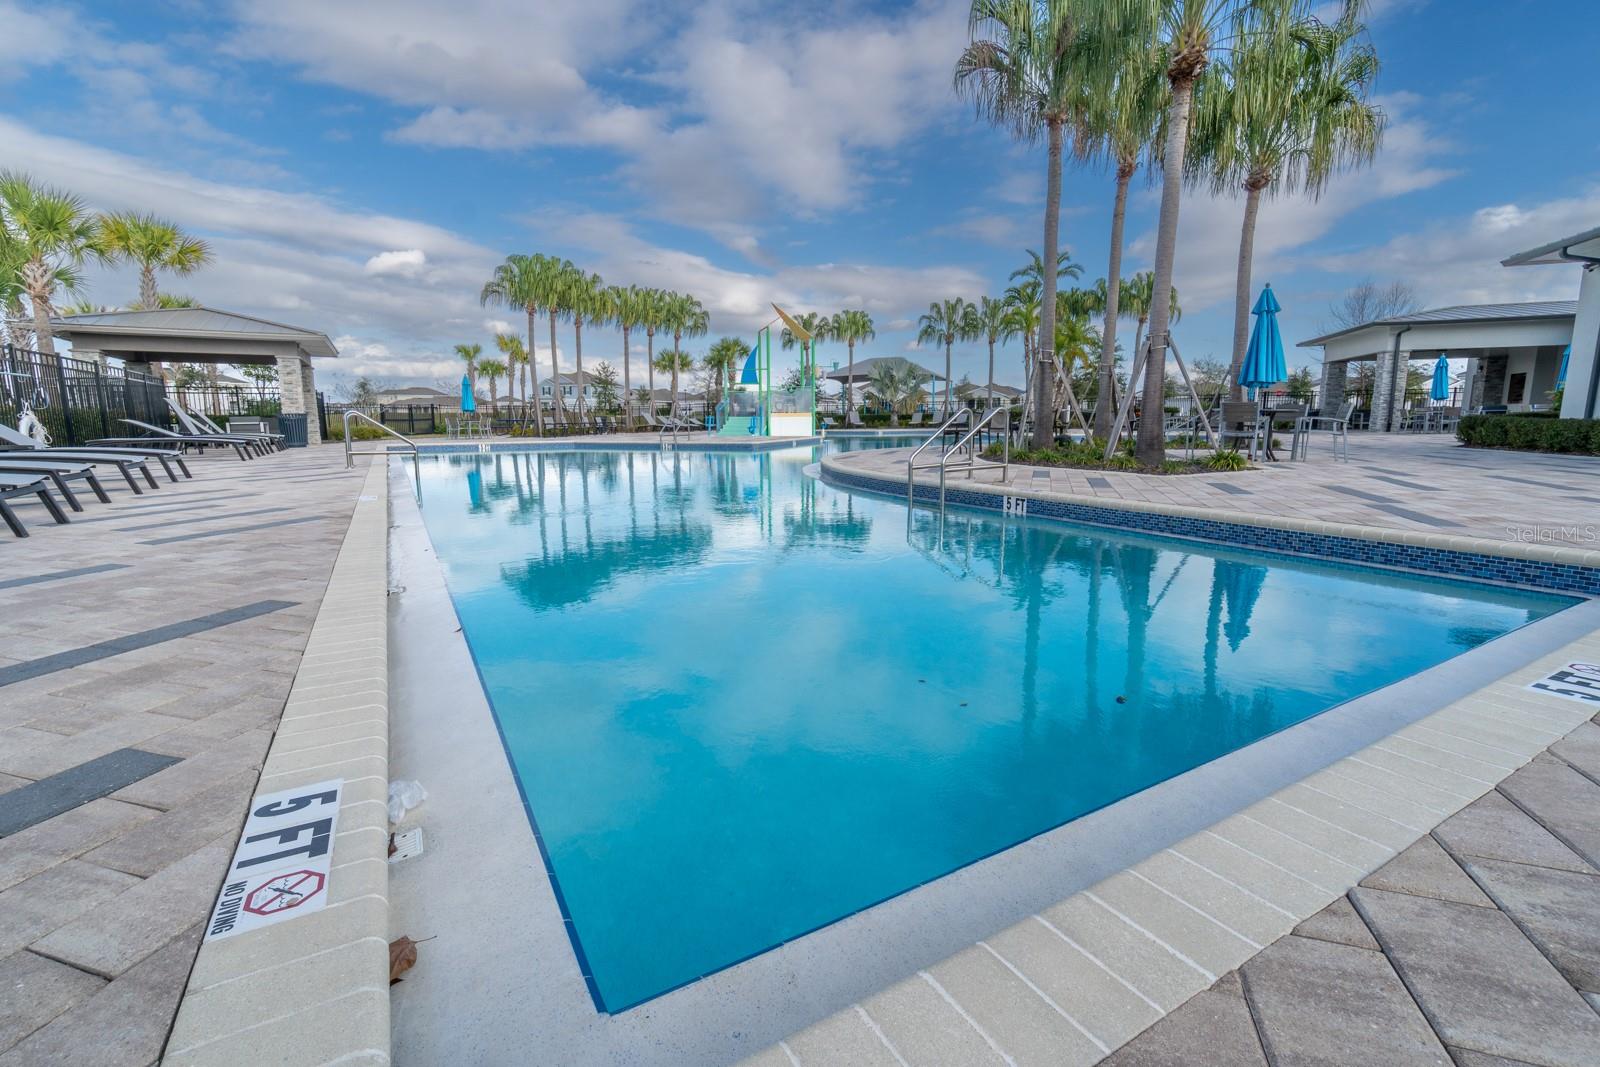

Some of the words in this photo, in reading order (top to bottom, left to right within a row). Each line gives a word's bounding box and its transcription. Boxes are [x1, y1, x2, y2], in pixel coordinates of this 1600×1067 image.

[1006, 497, 1012, 510] 5
[1015, 497, 1026, 511] FT
[253, 789, 338, 818] 5
[236, 817, 333, 869] FT
[224, 880, 248, 897] NO
[210, 896, 243, 936] DIVING
